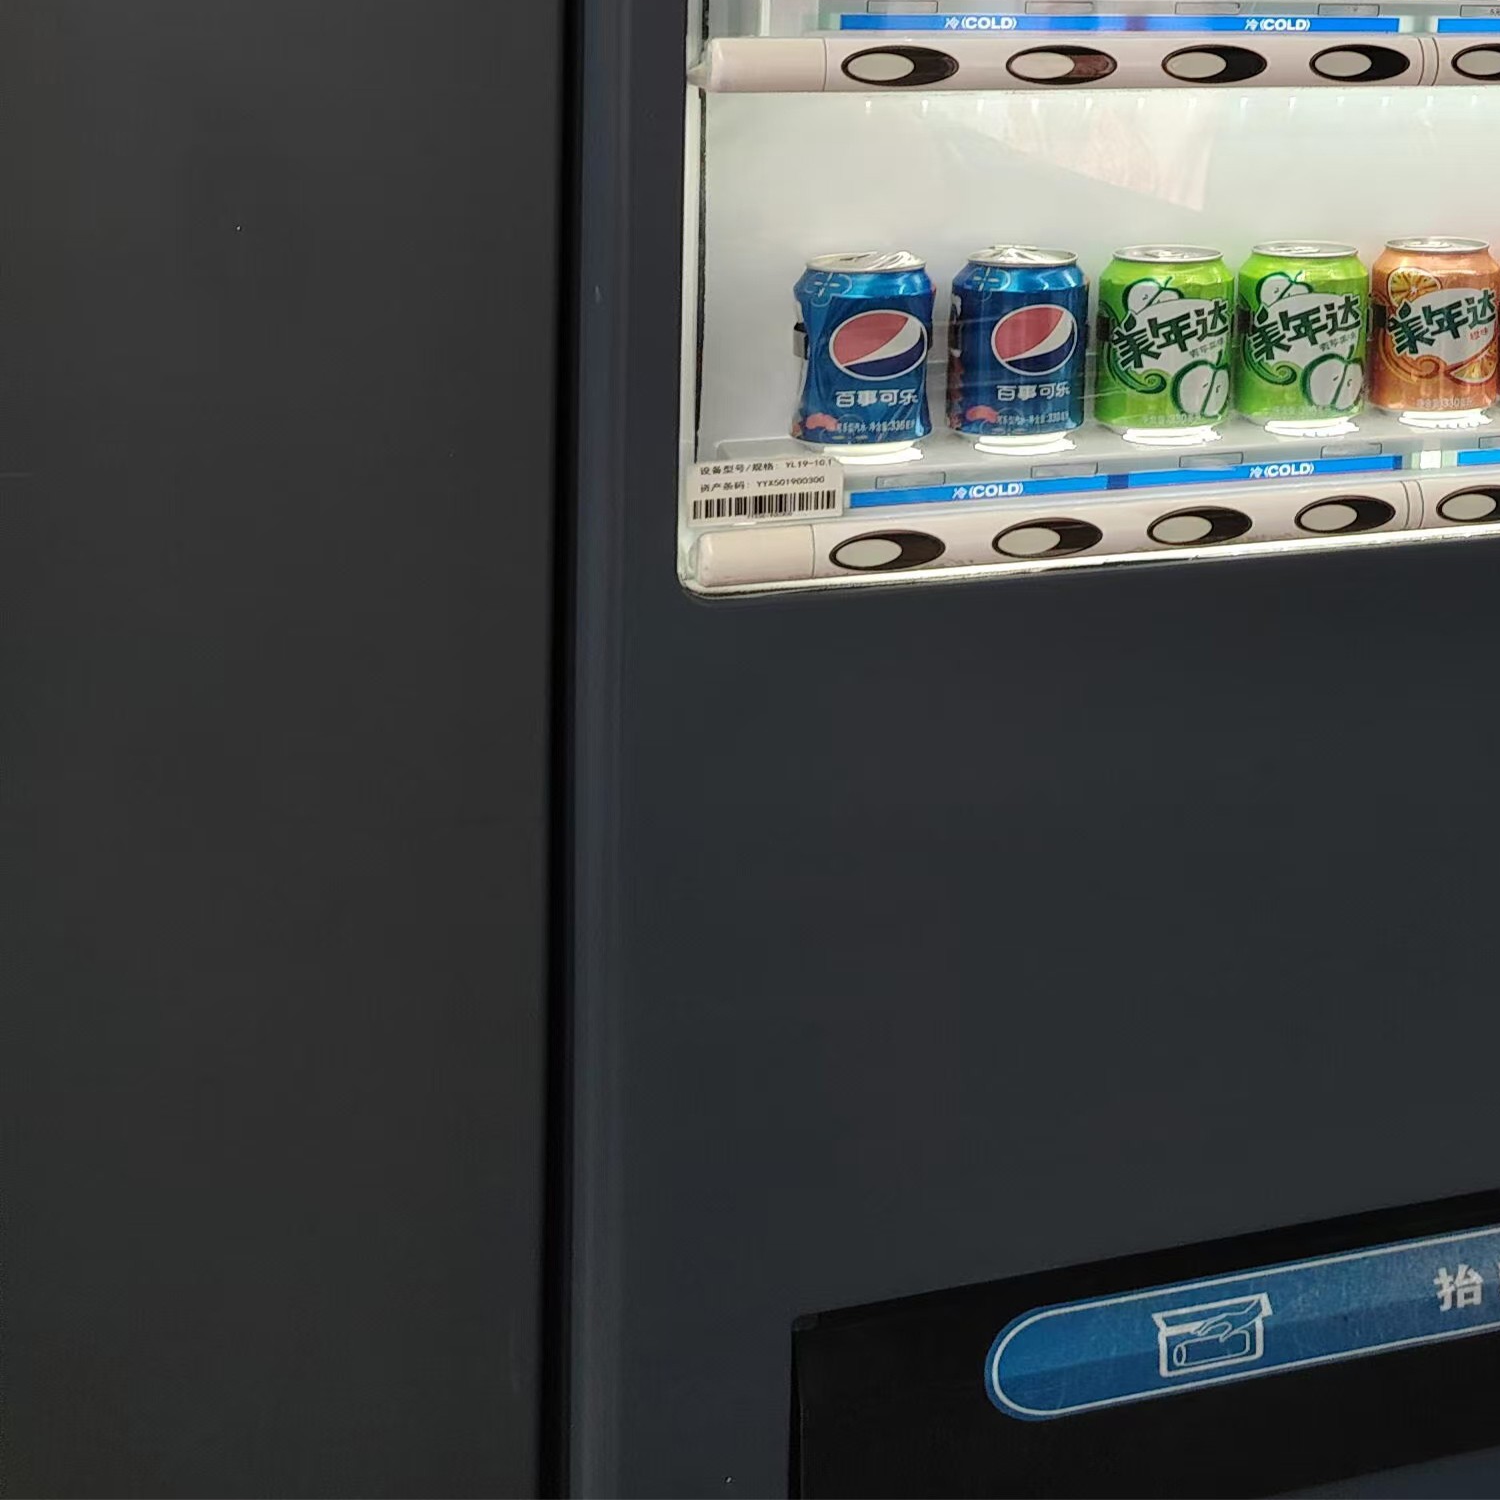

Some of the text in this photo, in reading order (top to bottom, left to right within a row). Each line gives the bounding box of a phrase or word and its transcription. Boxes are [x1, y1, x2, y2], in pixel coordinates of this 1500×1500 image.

[1113, 300, 1229, 369] 美年达
[1252, 295, 1361, 361] 美年达
[1388, 289, 1497, 354] 美年达
[835, 388, 918, 408] 百事可乐
[996, 381, 1071, 401] 百事可乐
